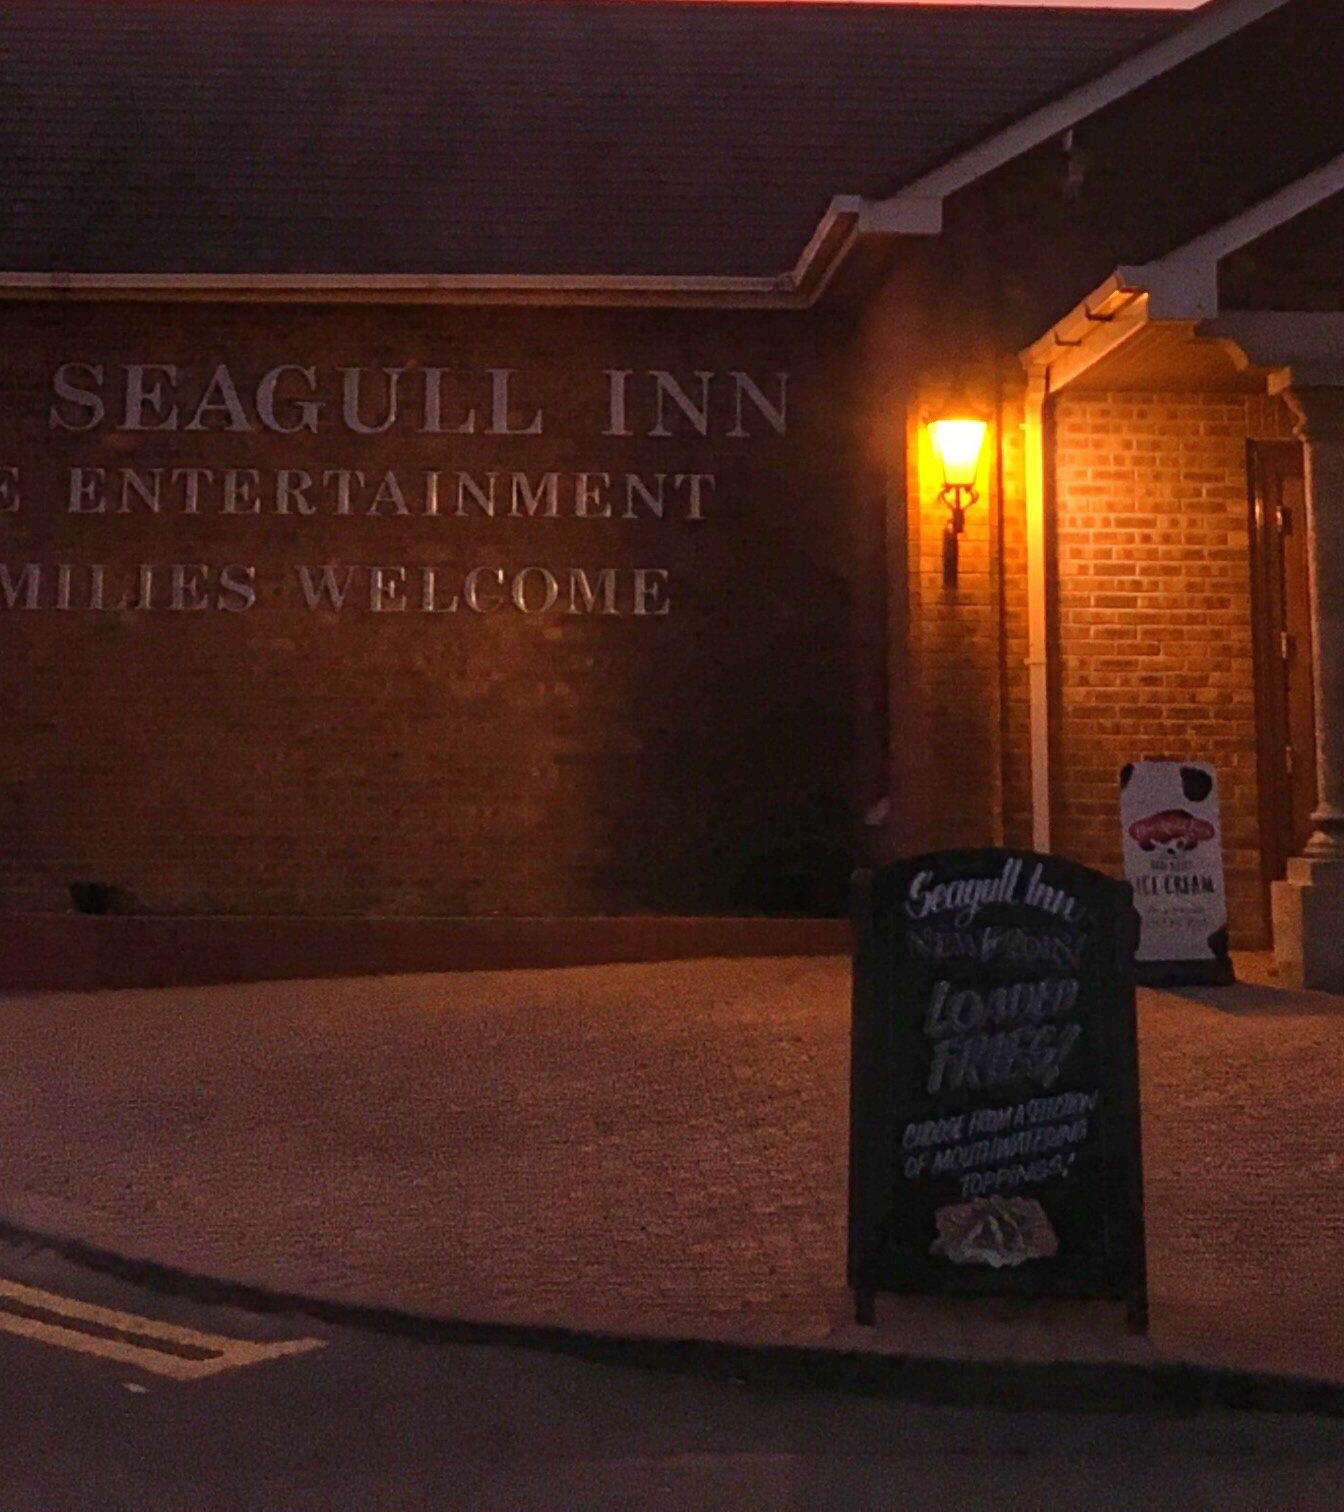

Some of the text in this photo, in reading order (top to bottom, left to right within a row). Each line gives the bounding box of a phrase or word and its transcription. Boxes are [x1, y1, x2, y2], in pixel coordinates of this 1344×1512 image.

[49, 362, 545, 436] SEAGULL
[600, 368, 792, 439] INN
[67, 467, 717, 521] ENTERTAINMENT
[294, 564, 672, 617] WELCOME
[904, 857, 1086, 928] Seagull Inn
[1136, 874, 1214, 896] ICE CREAM
[923, 979, 1079, 1037] LOADED
